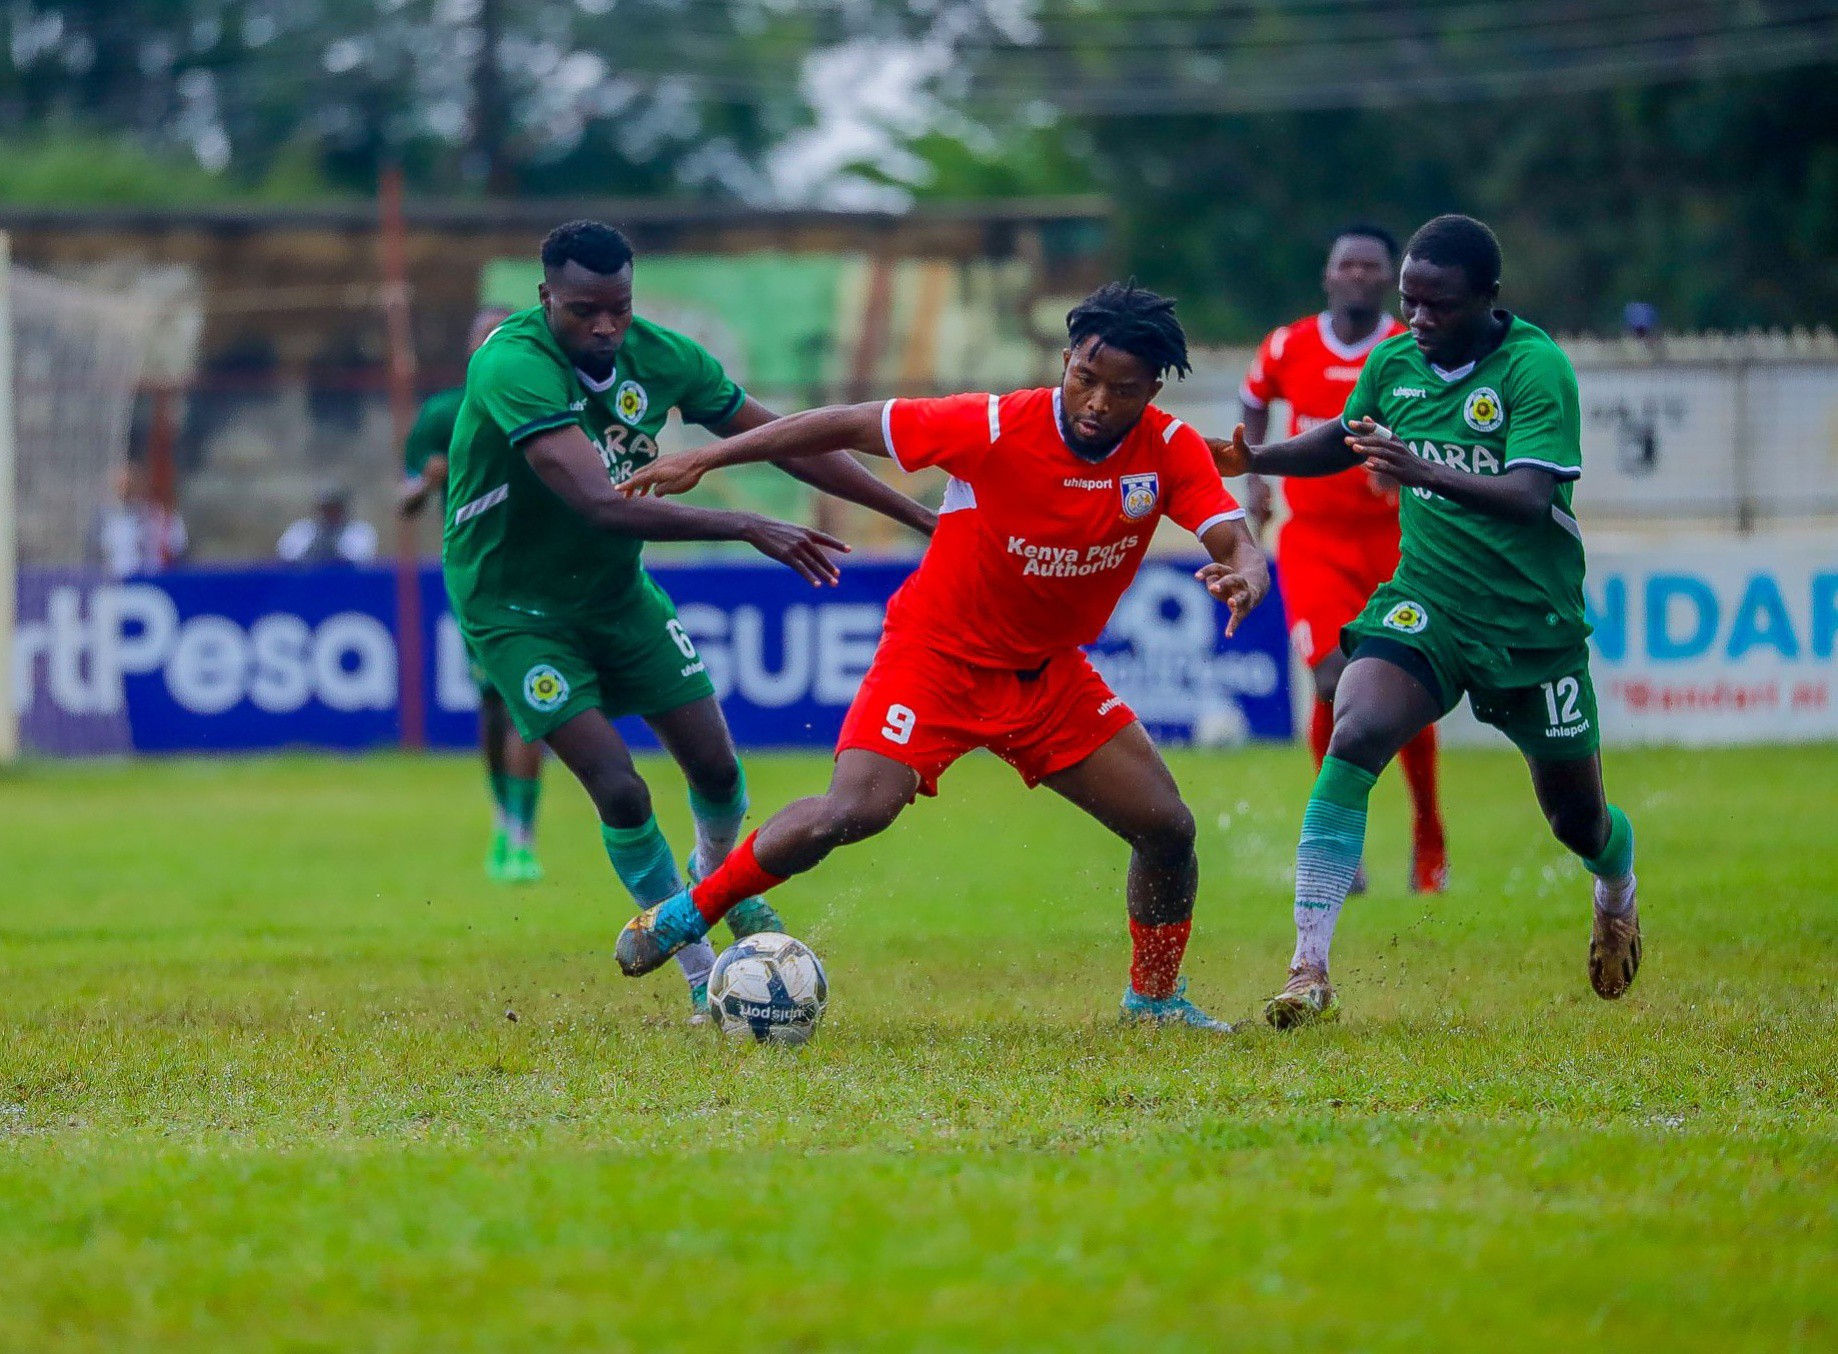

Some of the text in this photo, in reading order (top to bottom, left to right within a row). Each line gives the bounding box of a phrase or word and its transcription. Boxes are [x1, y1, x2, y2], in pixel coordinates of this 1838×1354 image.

[1408, 440, 1499, 475] ARA
[1063, 478, 1113, 491] uhlsport
[1007, 535, 1139, 566] Kenya Ports
[1022, 552, 1126, 578] Authority
[666, 619, 696, 659] 6
[1540, 676, 1582, 725] 12
[881, 703, 916, 745] 9
[1546, 719, 1589, 737] uhlsport
